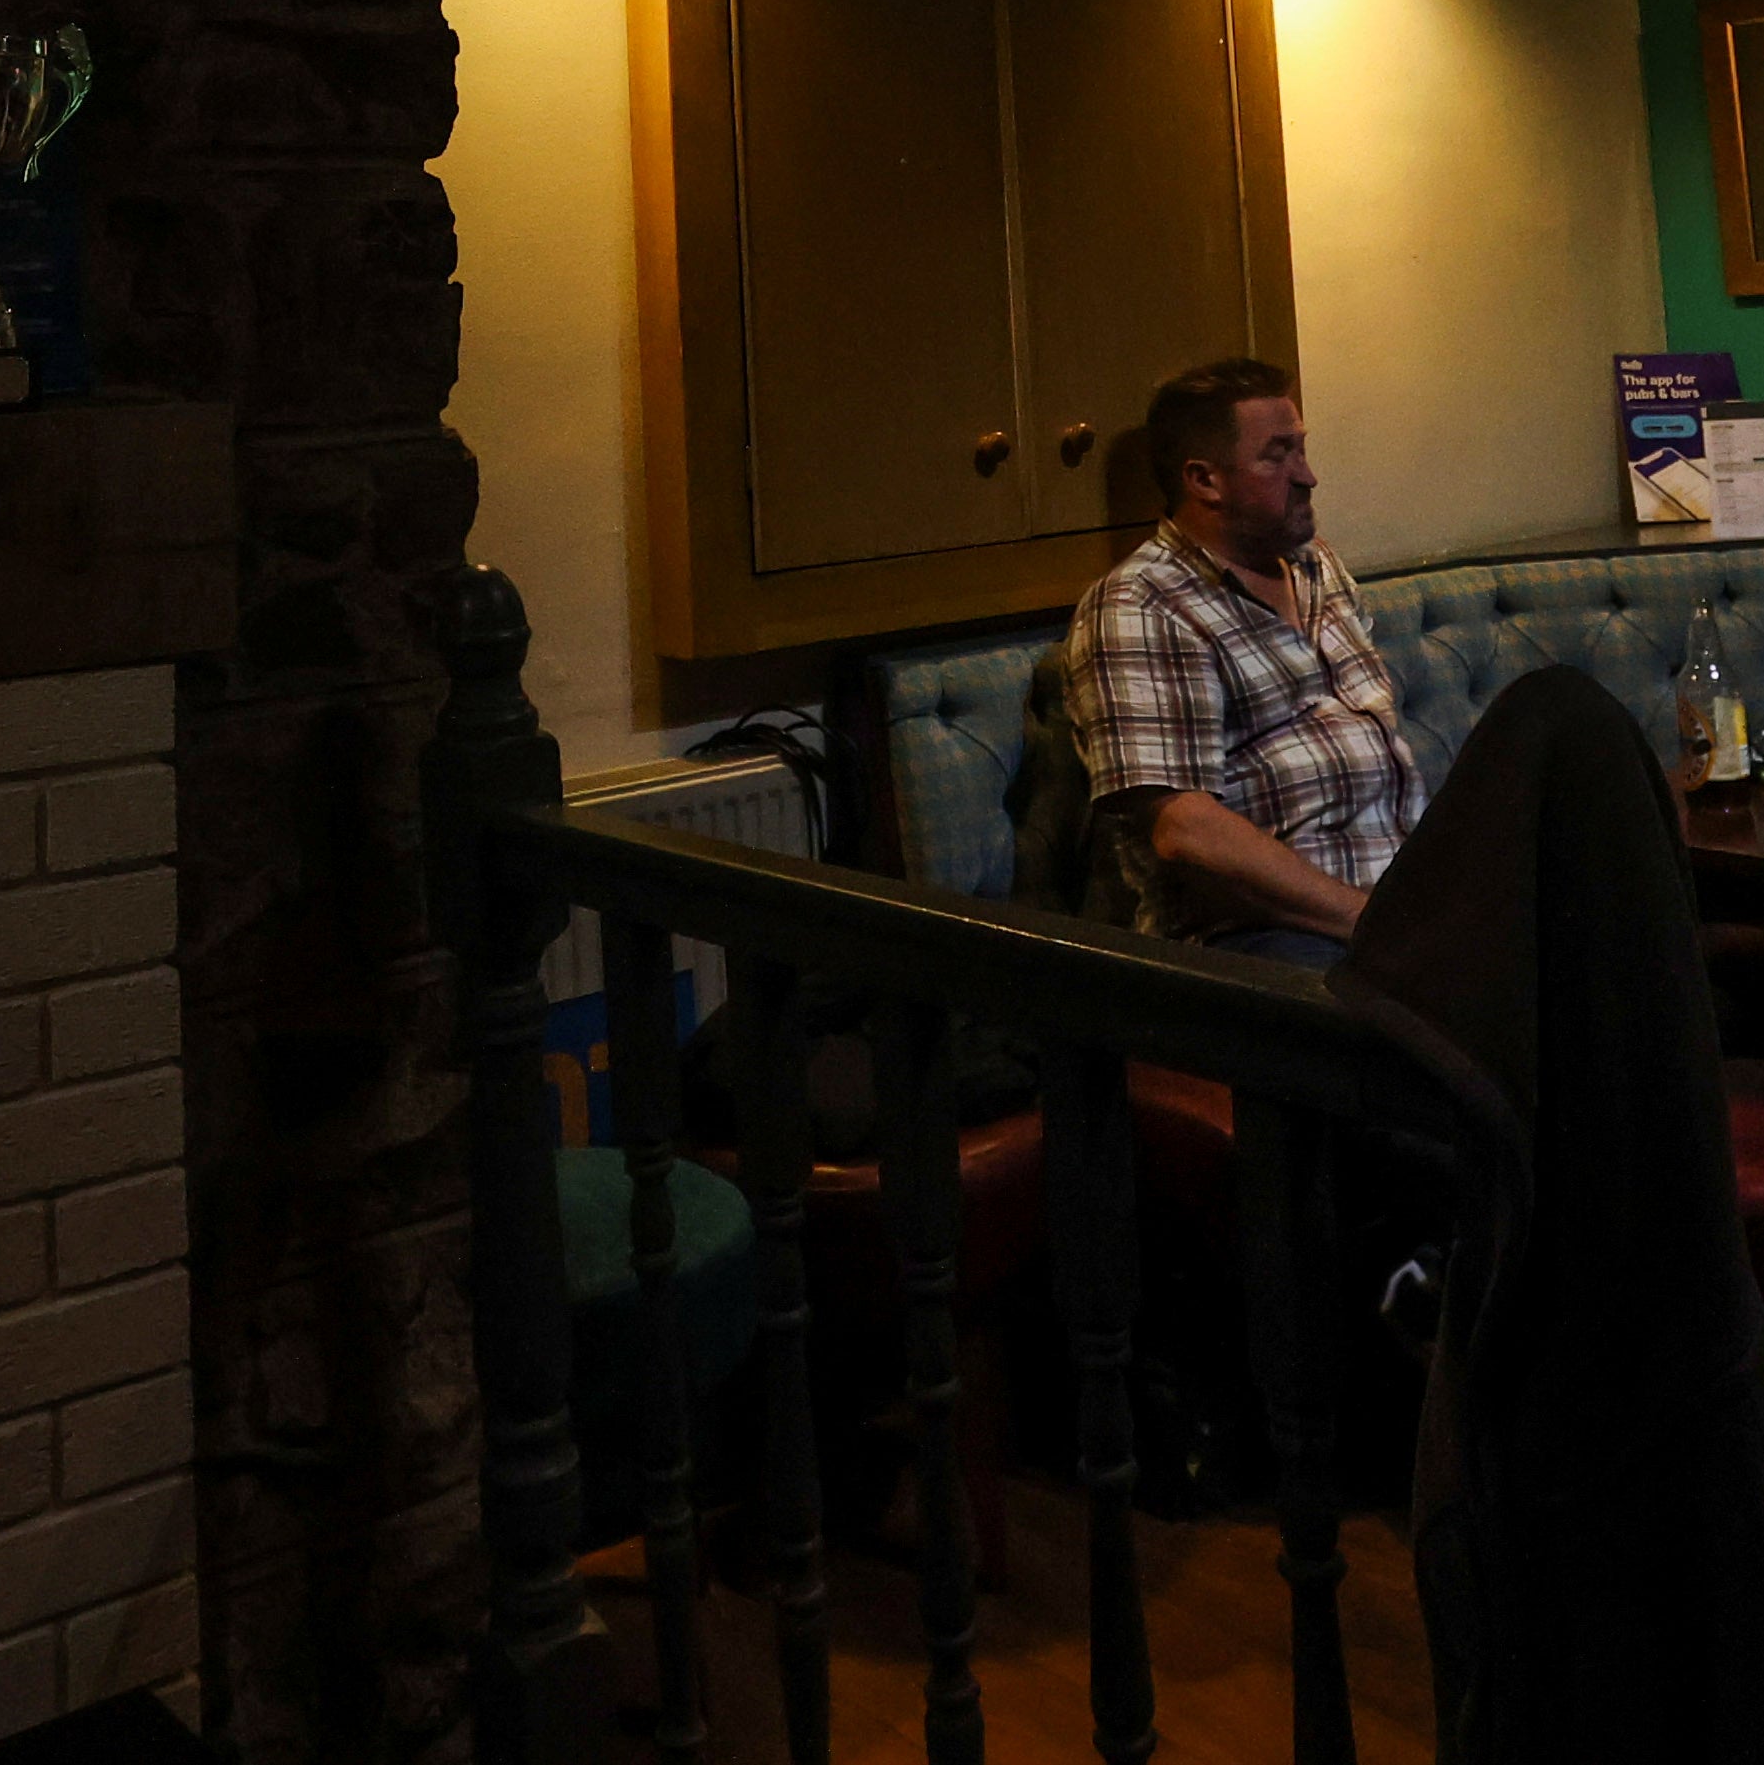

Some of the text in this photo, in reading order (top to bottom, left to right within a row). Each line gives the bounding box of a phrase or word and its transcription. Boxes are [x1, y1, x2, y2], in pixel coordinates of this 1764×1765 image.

[1622, 373, 1697, 387] The app for
[1625, 388, 1700, 401] pubs & bars
